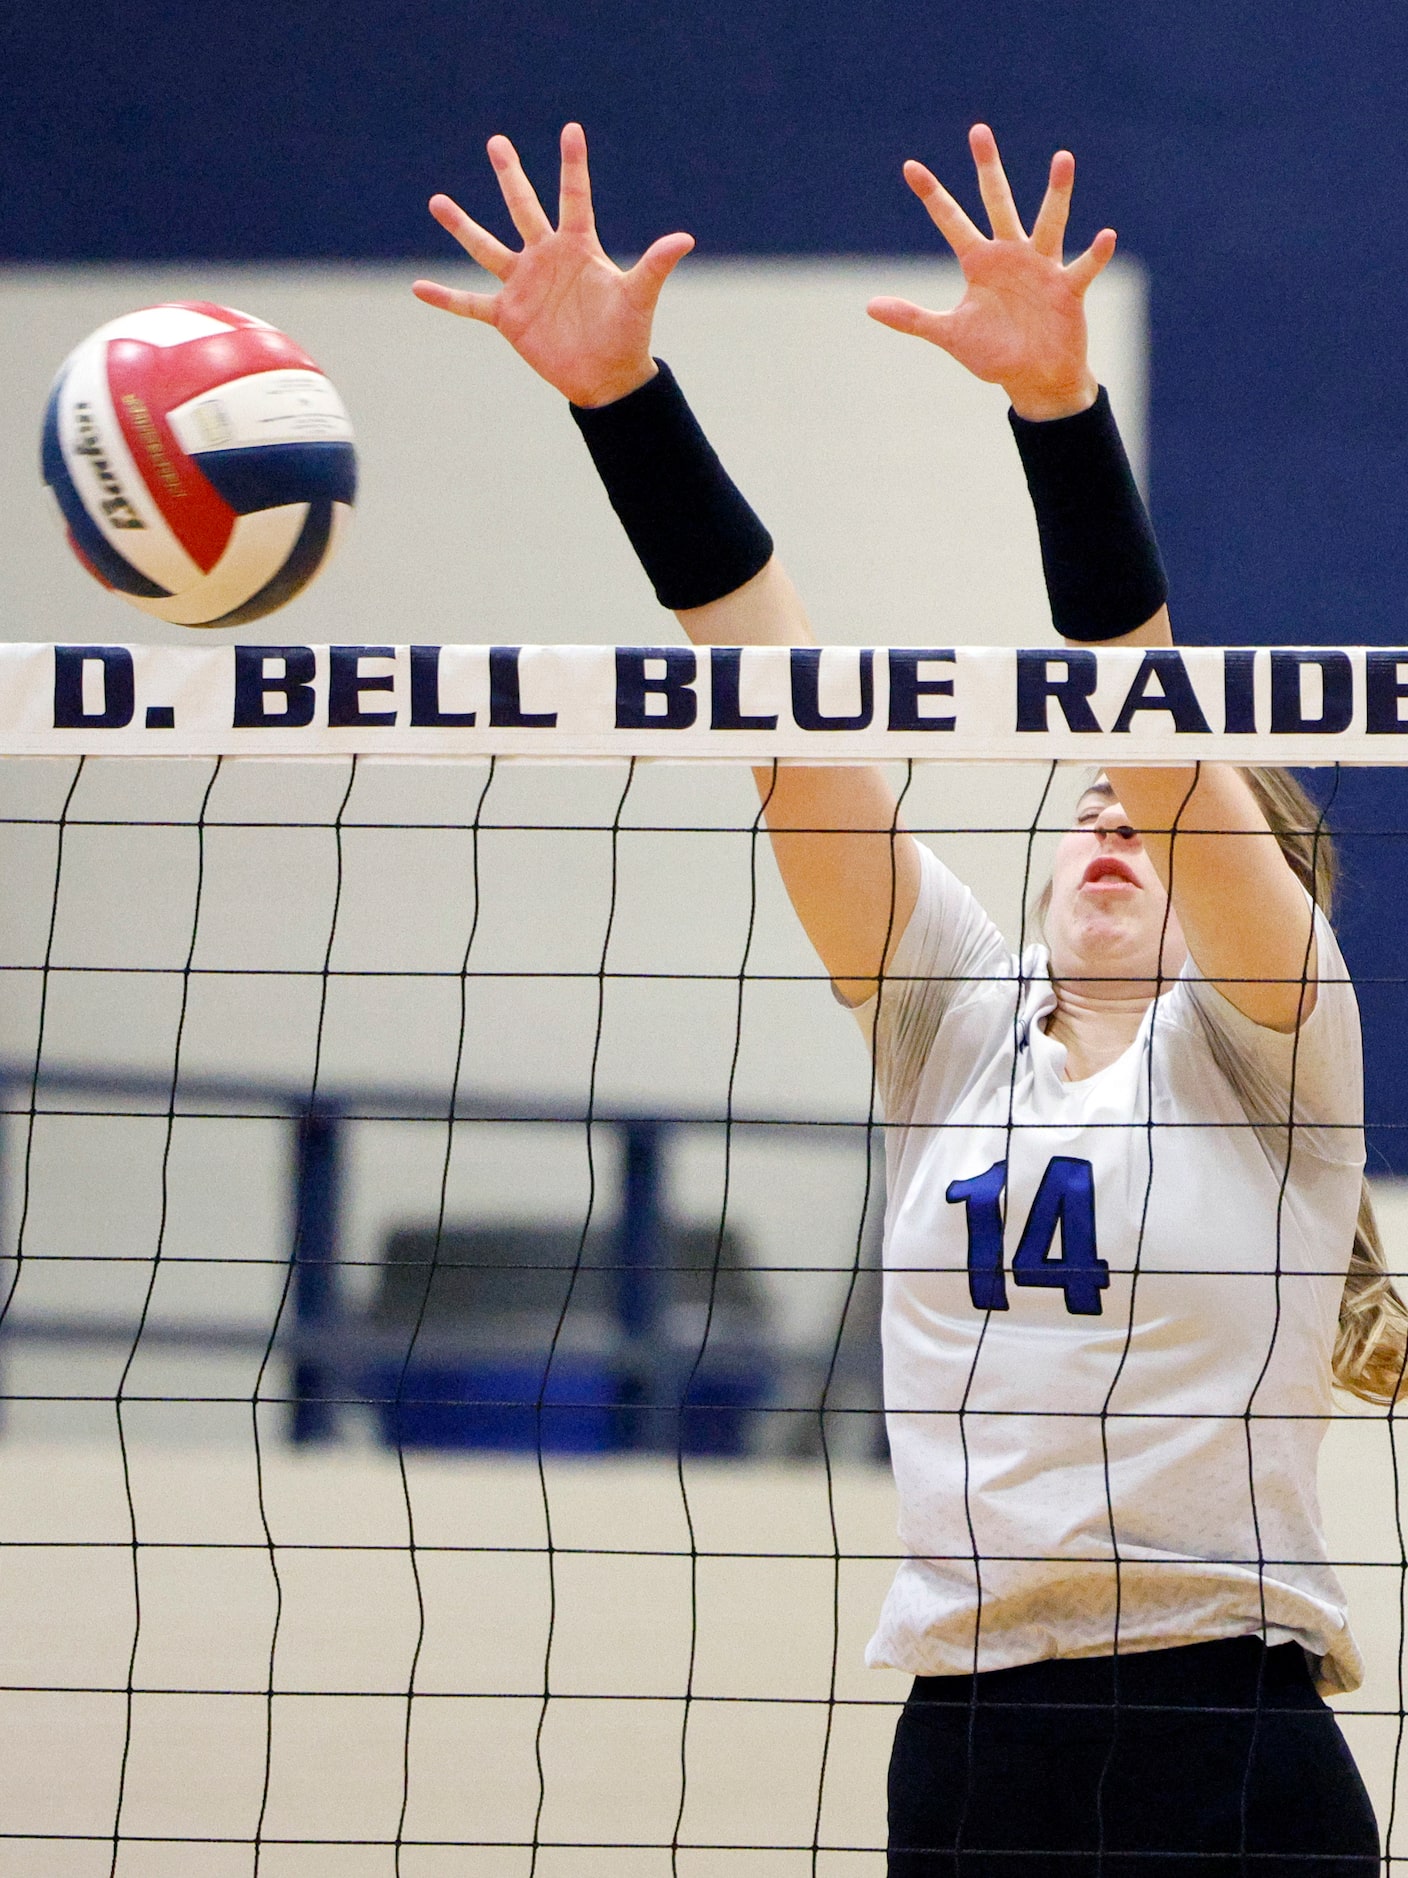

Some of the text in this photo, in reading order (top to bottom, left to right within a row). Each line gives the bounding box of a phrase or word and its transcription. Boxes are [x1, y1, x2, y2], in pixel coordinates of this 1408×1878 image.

[52, 646, 175, 730] D.
[232, 646, 558, 729] BELL
[614, 648, 957, 732] BLUE
[945, 1156, 1110, 1316] 14
